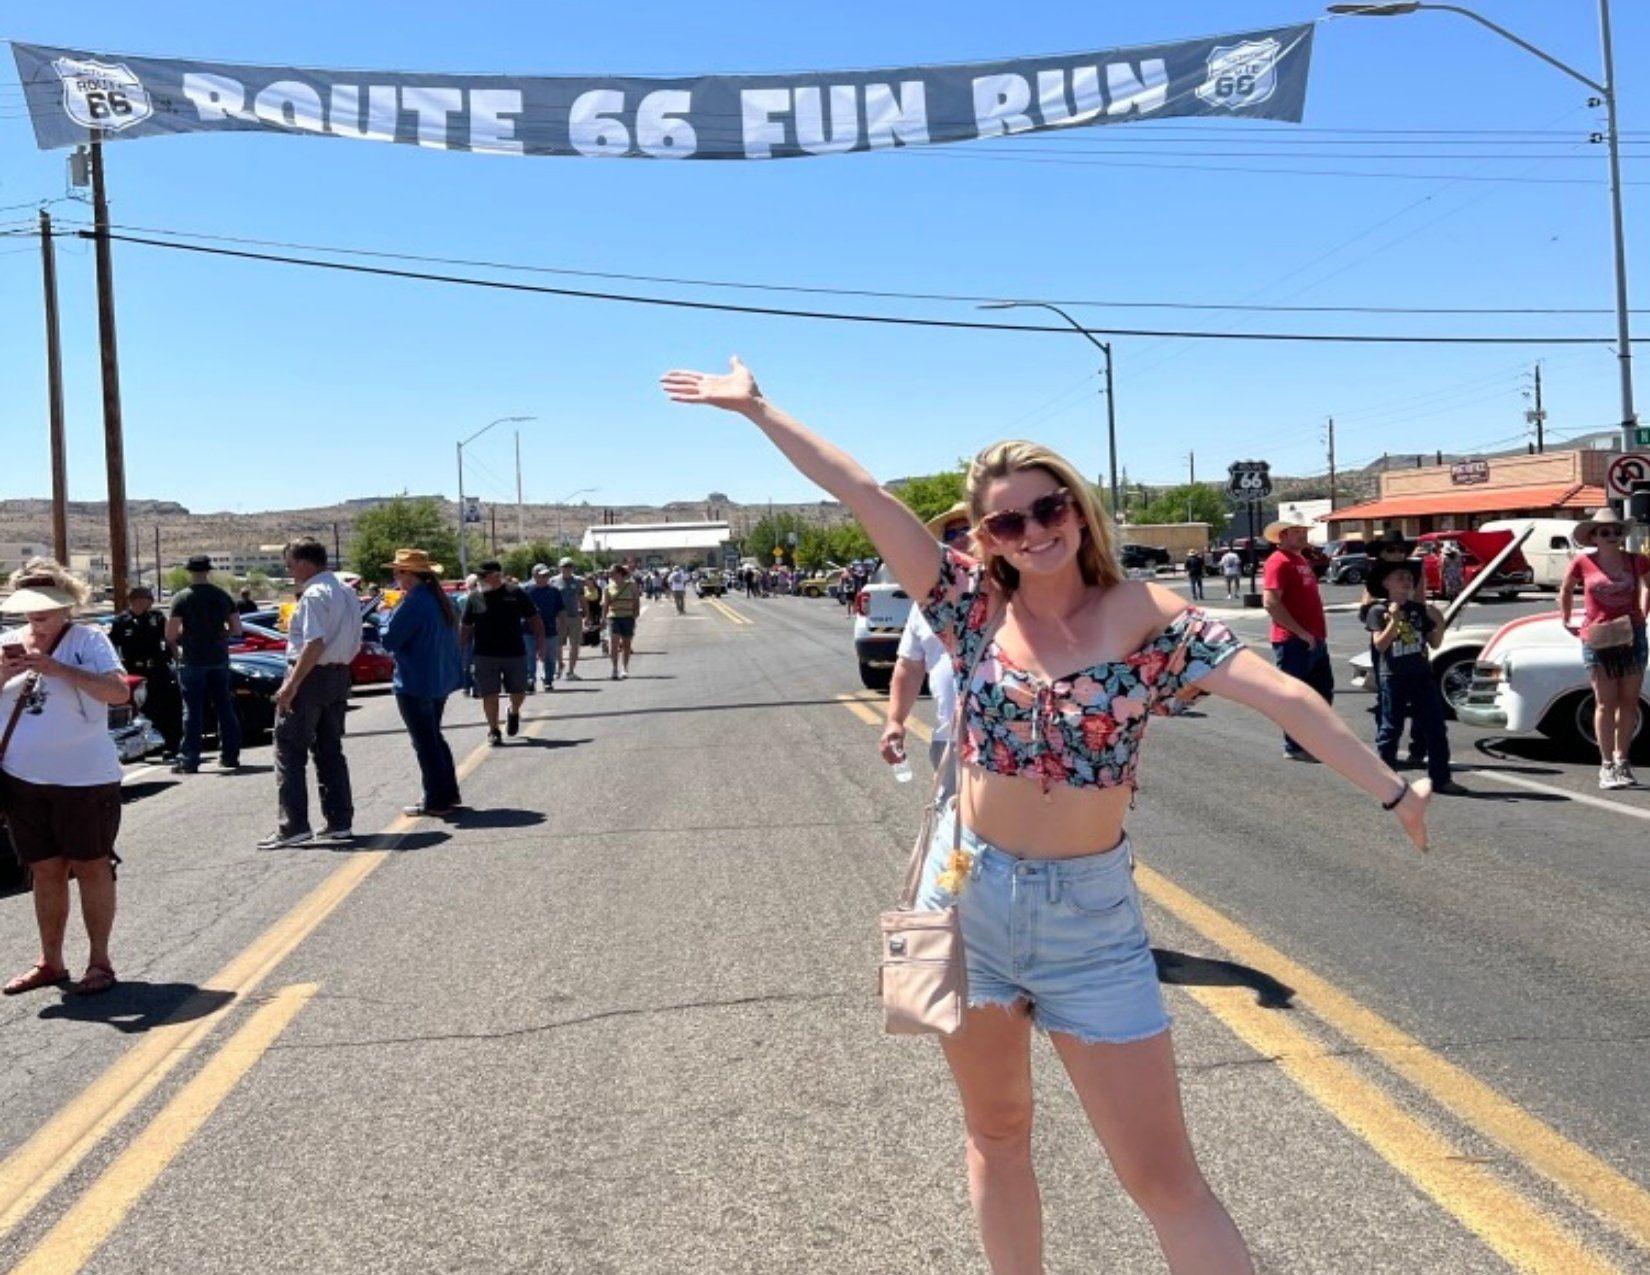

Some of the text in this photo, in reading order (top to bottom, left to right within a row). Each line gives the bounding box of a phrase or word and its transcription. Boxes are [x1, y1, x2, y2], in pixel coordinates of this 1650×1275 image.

[1214, 74, 1256, 98] 66
[86, 90, 132, 119] 66
[183, 58, 1169, 159] ROUTE 66 FUN RUN
[1240, 471, 1262, 489] 66
